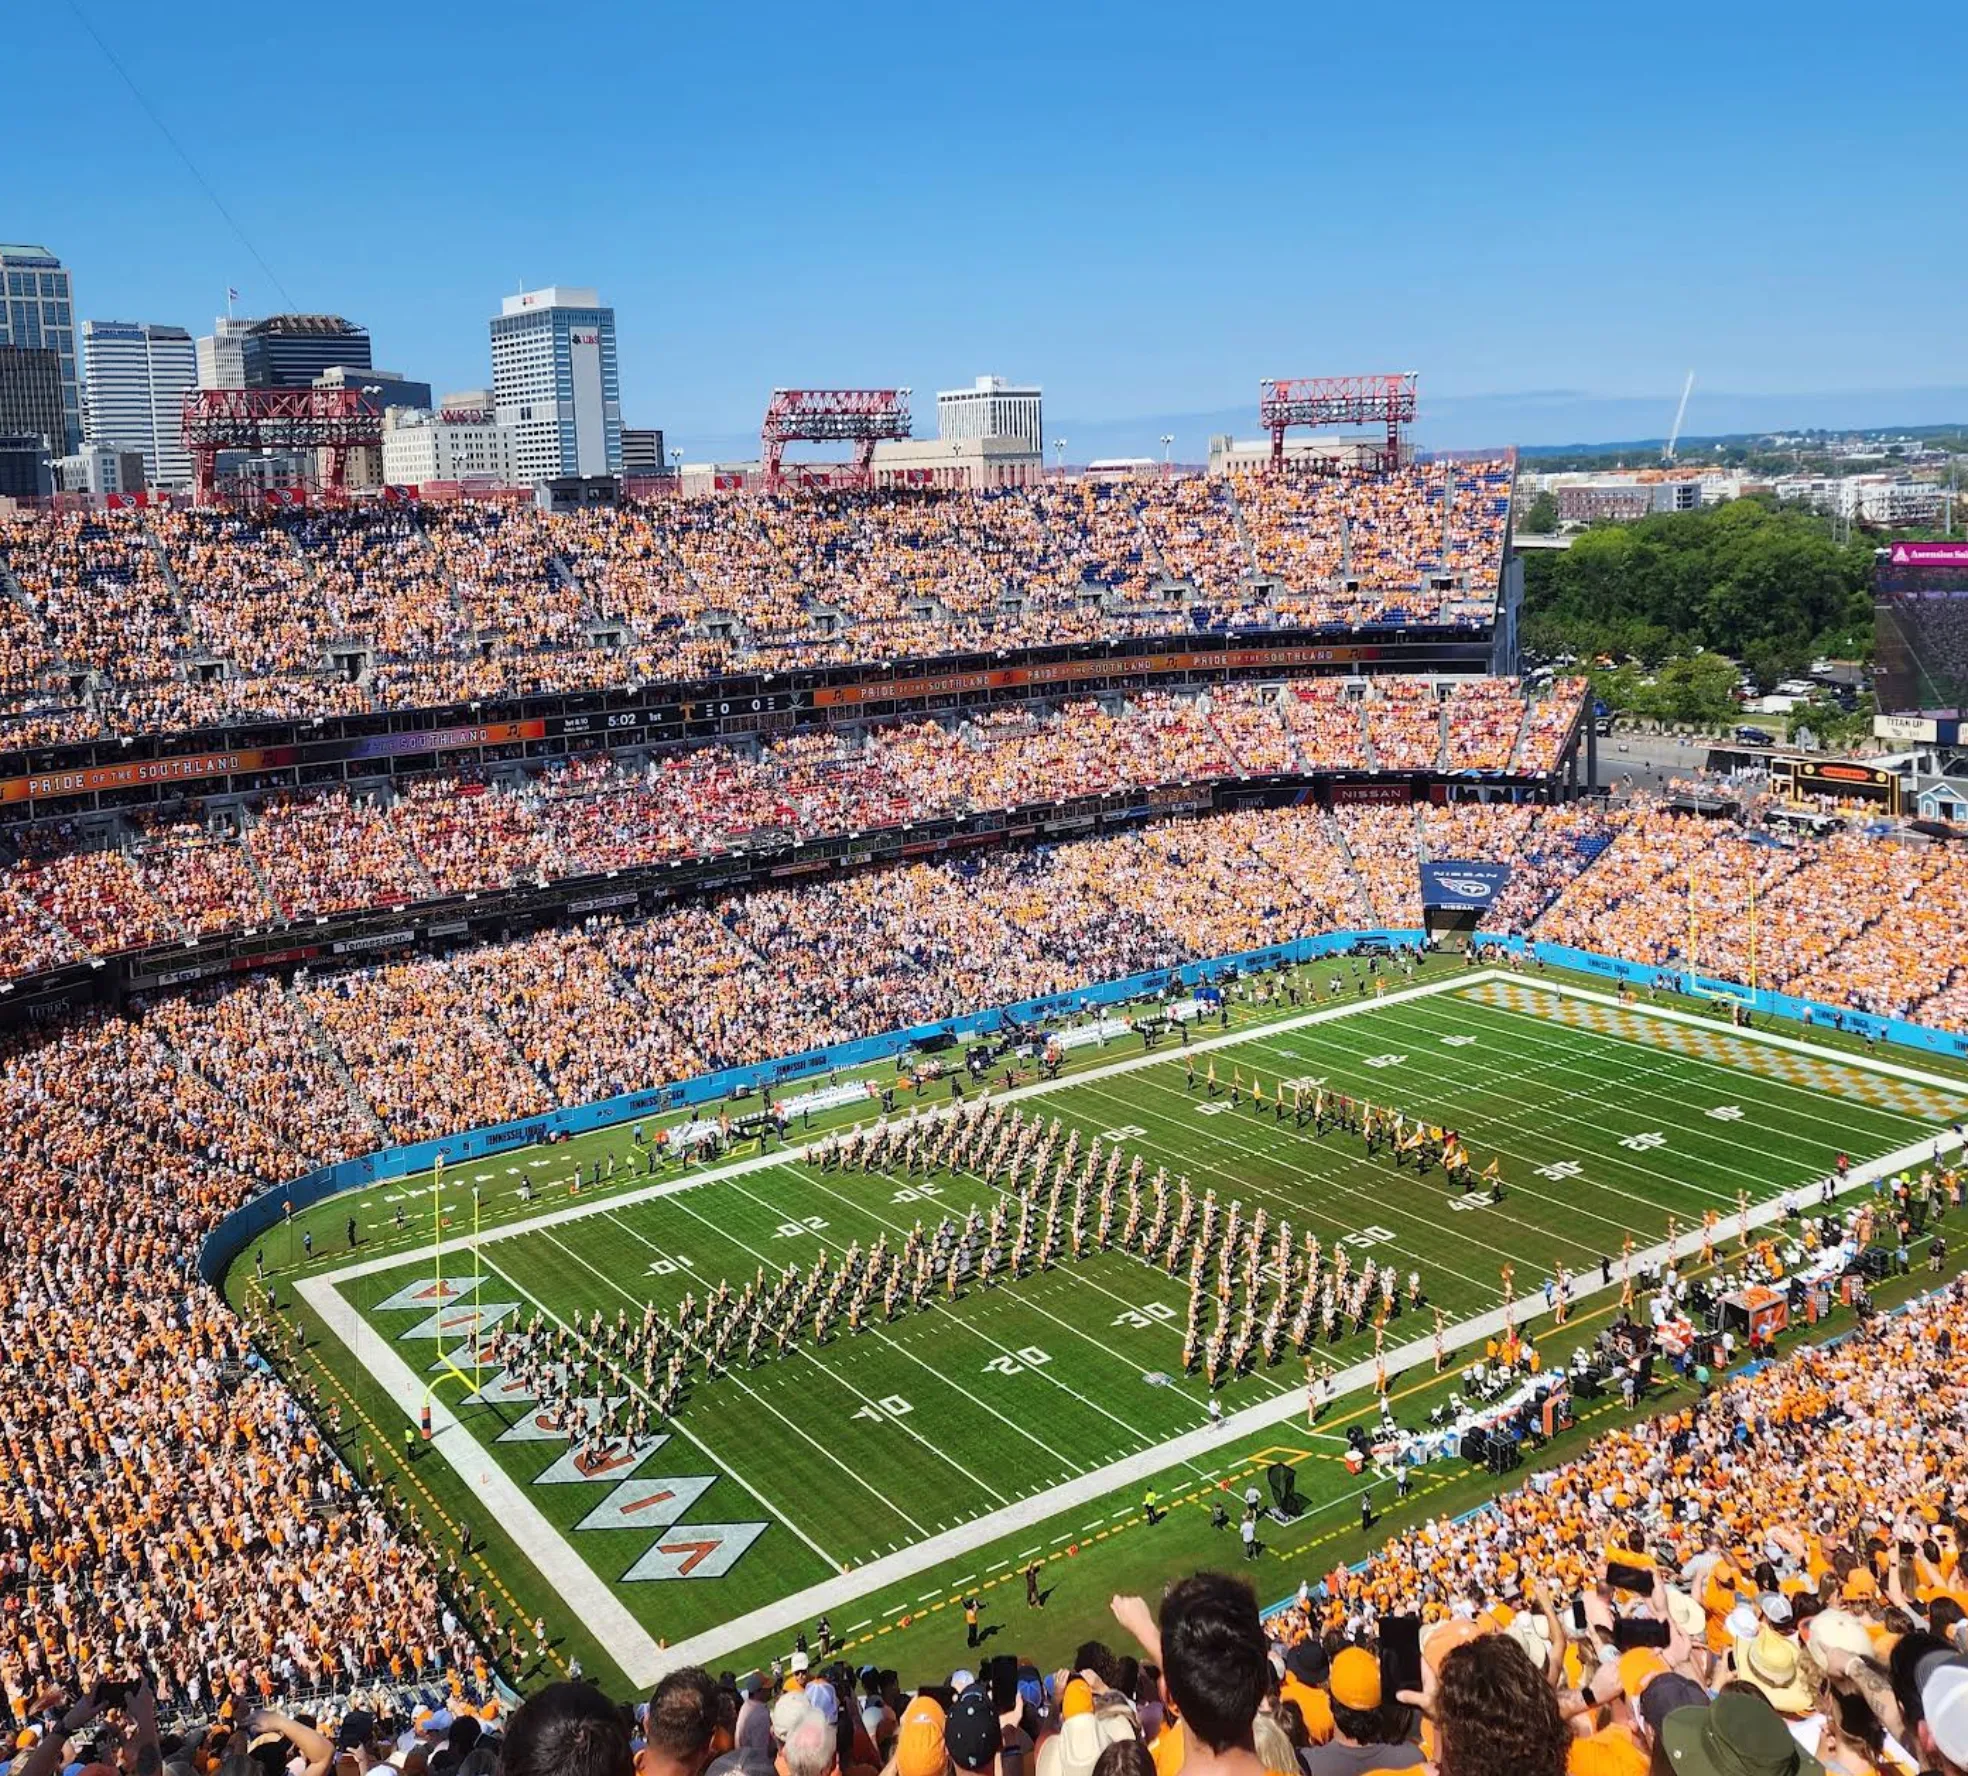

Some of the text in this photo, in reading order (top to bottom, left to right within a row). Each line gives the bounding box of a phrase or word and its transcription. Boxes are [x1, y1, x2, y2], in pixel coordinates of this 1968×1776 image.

[582, 335, 599, 345] UBS
[1193, 655, 1228, 666] PRIDE
[1263, 649, 1334, 662] SOUTHLAND
[1027, 668, 1058, 680] PRIDE
[1089, 660, 1151, 673] SOUTHLAND
[860, 685, 895, 699] PRIDE
[928, 675, 990, 690] SOUTHLAND
[720, 702, 730, 714] 0
[751, 699, 761, 710] 0
[608, 713, 637, 727] 5:02
[648, 712, 662, 721] 1st
[1887, 717, 1925, 728] TITAN UP
[399, 729, 488, 749] SOUTHLAND
[28, 756, 239, 793] PRIDE OF THE SOUTHLAND
[1342, 790, 1401, 799] NISSAN
[486, 1128, 522, 1146] TENNESSEE
[1101, 1125, 1148, 1142] 50
[1617, 1132, 1667, 1152] 20
[1532, 1161, 1584, 1181] 30
[893, 1183, 944, 1203] 30
[1447, 1192, 1494, 1211] 40
[776, 1216, 831, 1237] 20
[1342, 1225, 1397, 1249] 50
[649, 1255, 694, 1275] 10
[1116, 1301, 1178, 1329] 30
[989, 1345, 1053, 1375] 20
[860, 1394, 914, 1422] 10
